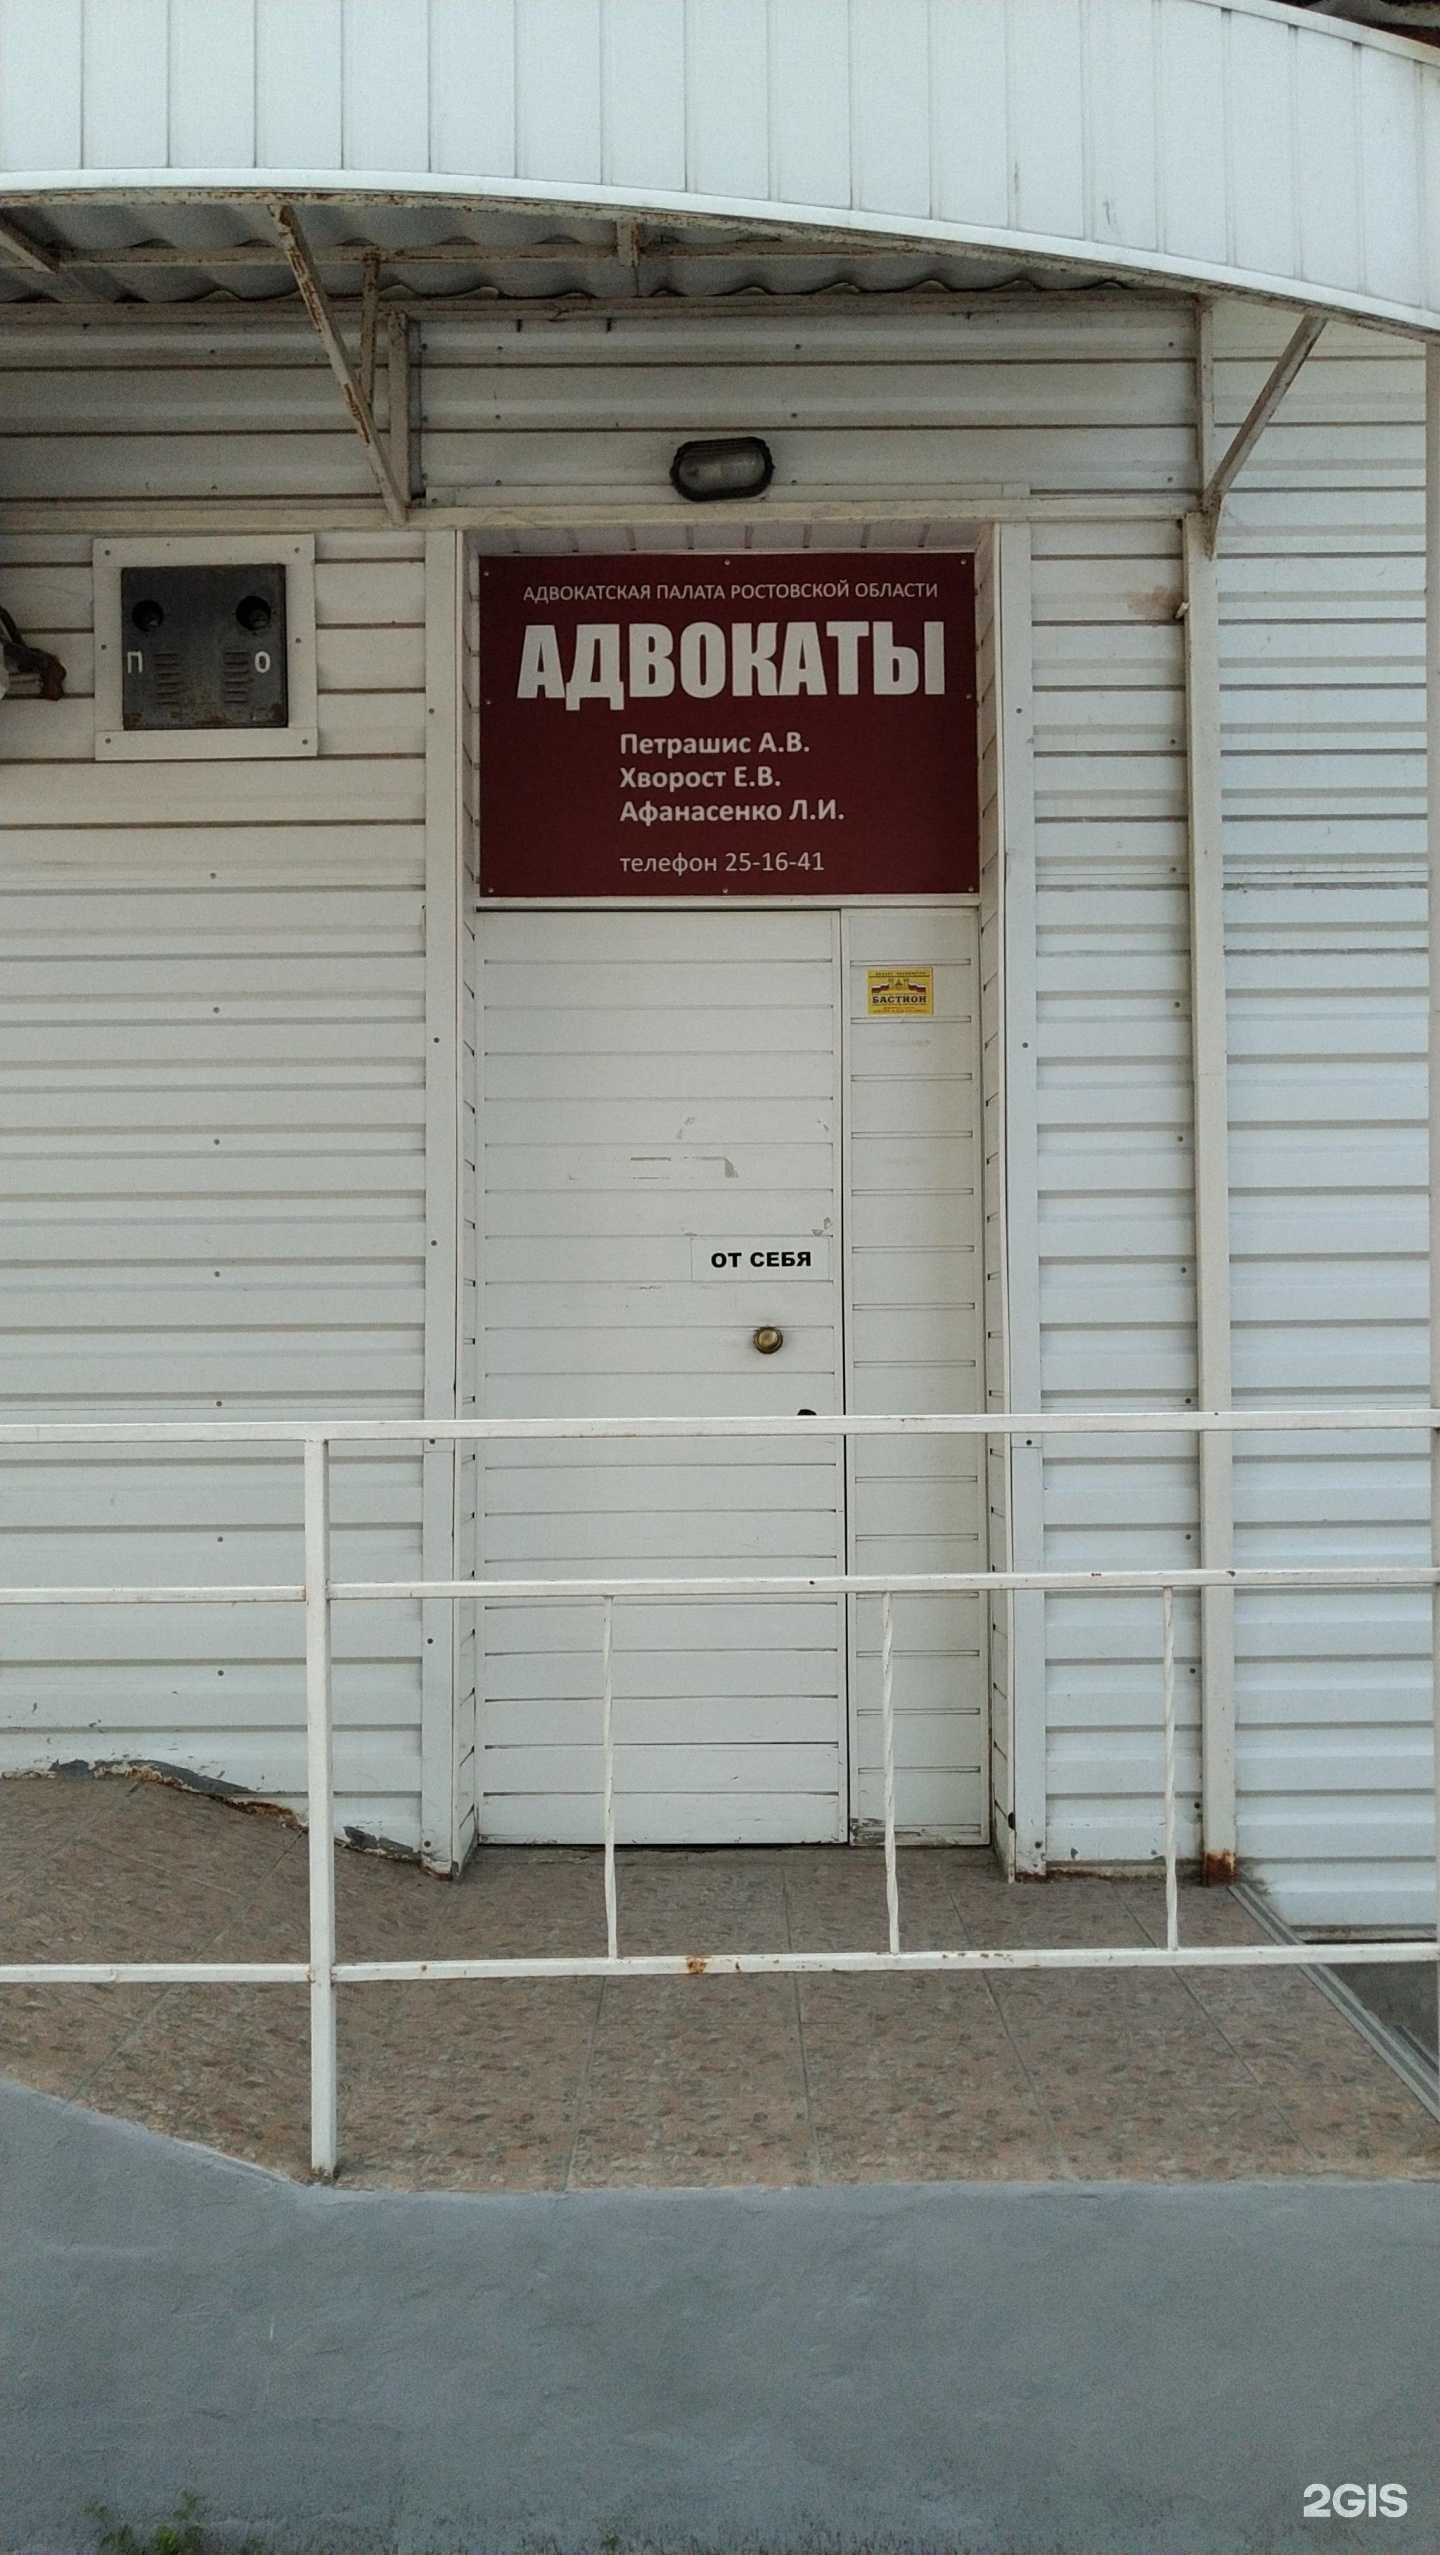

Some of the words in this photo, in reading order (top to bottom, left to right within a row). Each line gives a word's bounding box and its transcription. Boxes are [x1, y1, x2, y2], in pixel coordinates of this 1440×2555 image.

[523, 583, 651, 602] АДВОКАТСКАЯ
[656, 583, 725, 600] ПАЛАТА
[731, 579, 849, 599] РОСТОВСКОЙ
[855, 582, 939, 598] ОБЛАСТИ
[517, 621, 945, 711] АДВОКАТЫ
[620, 733, 751, 758] Петрашис
[758, 732, 810, 753] А.В.
[620, 767, 726, 792] Хворост
[734, 766, 781, 787] Е.В.
[620, 801, 782, 826] Афанасенко
[789, 799, 845, 820] Л.И.
[620, 853, 717, 876] телефон
[725, 852, 825, 872] 25-16-41
[711, 1252, 742, 1268] ОТ
[750, 1251, 811, 1267] СЕБЯ
